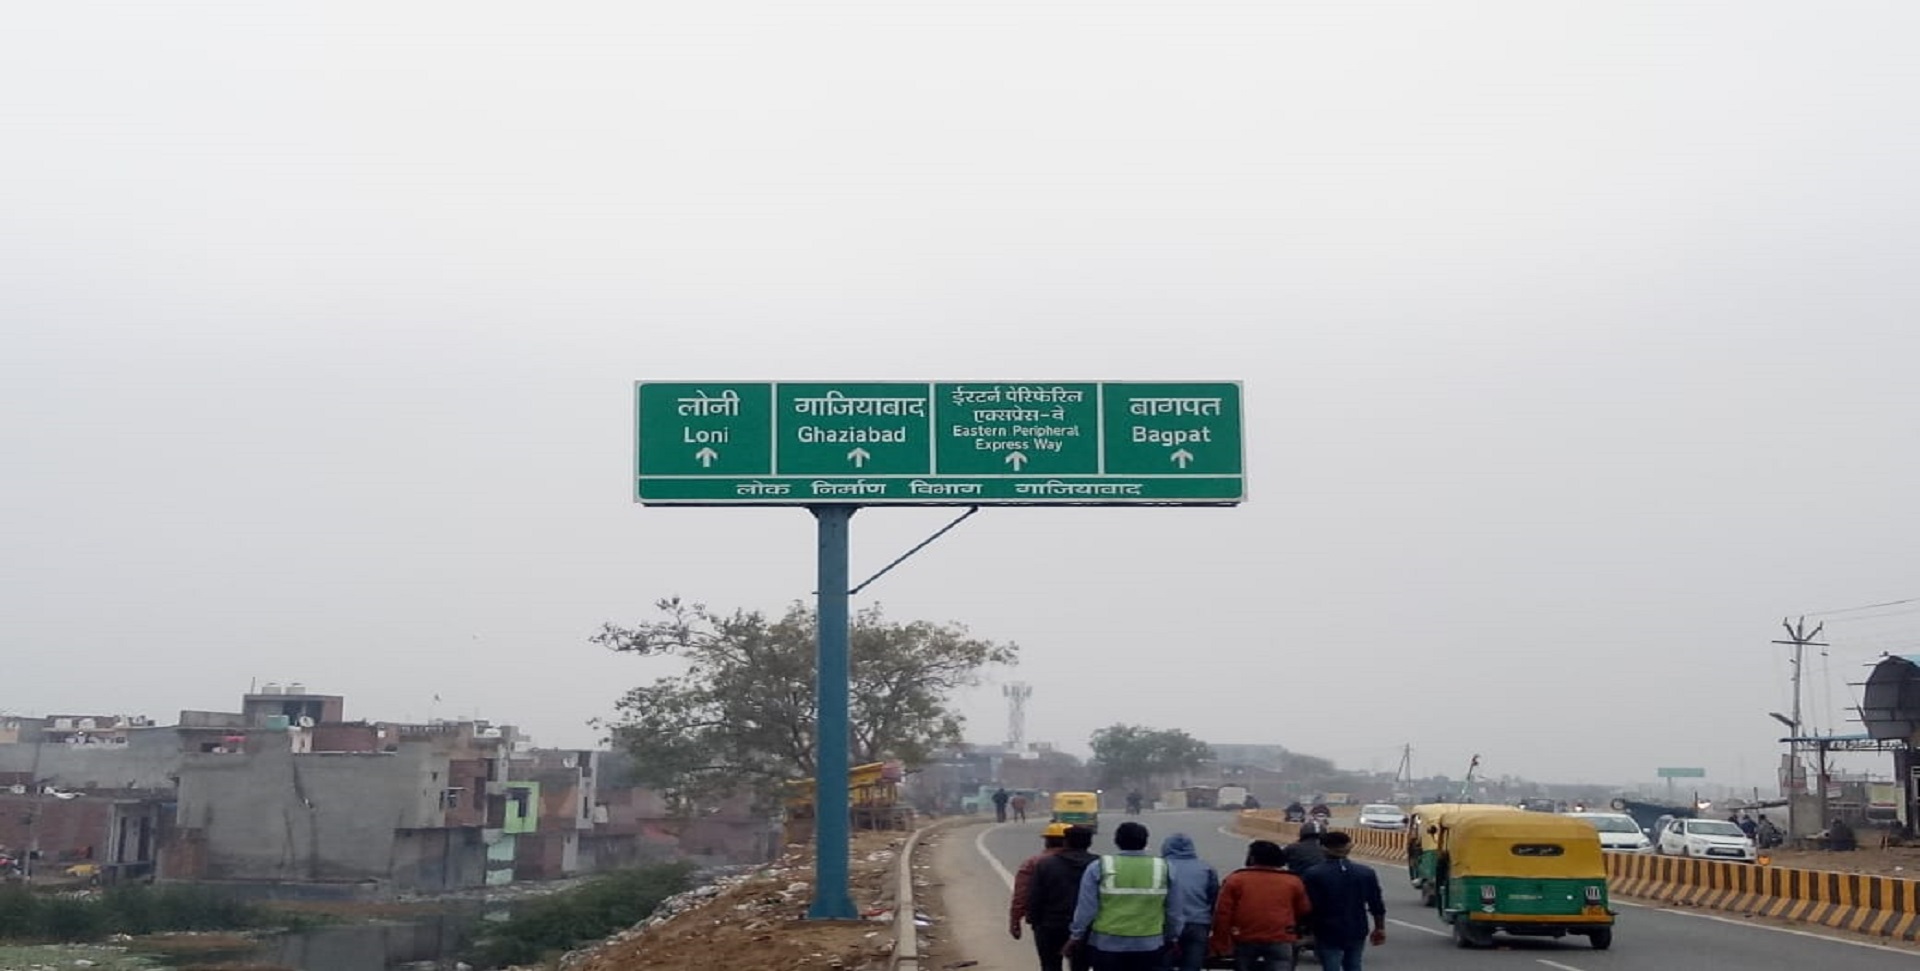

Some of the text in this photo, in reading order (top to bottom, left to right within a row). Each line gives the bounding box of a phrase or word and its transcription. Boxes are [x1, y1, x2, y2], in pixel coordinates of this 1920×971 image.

[677, 389, 740, 416] लोनी
[794, 390, 926, 417] गाजियाबाद
[1129, 397, 1222, 416] बागपत
[684, 426, 728, 443] Loni
[798, 426, 906, 443] Ghaziabad
[953, 425, 1079, 440] Eastern Peripheral
[1132, 426, 1211, 446] Bagpat
[975, 438, 1063, 452] Express Way
[737, 480, 791, 495] लोक
[811, 479, 886, 495] निर्माण
[908, 479, 983, 495] विभाग
